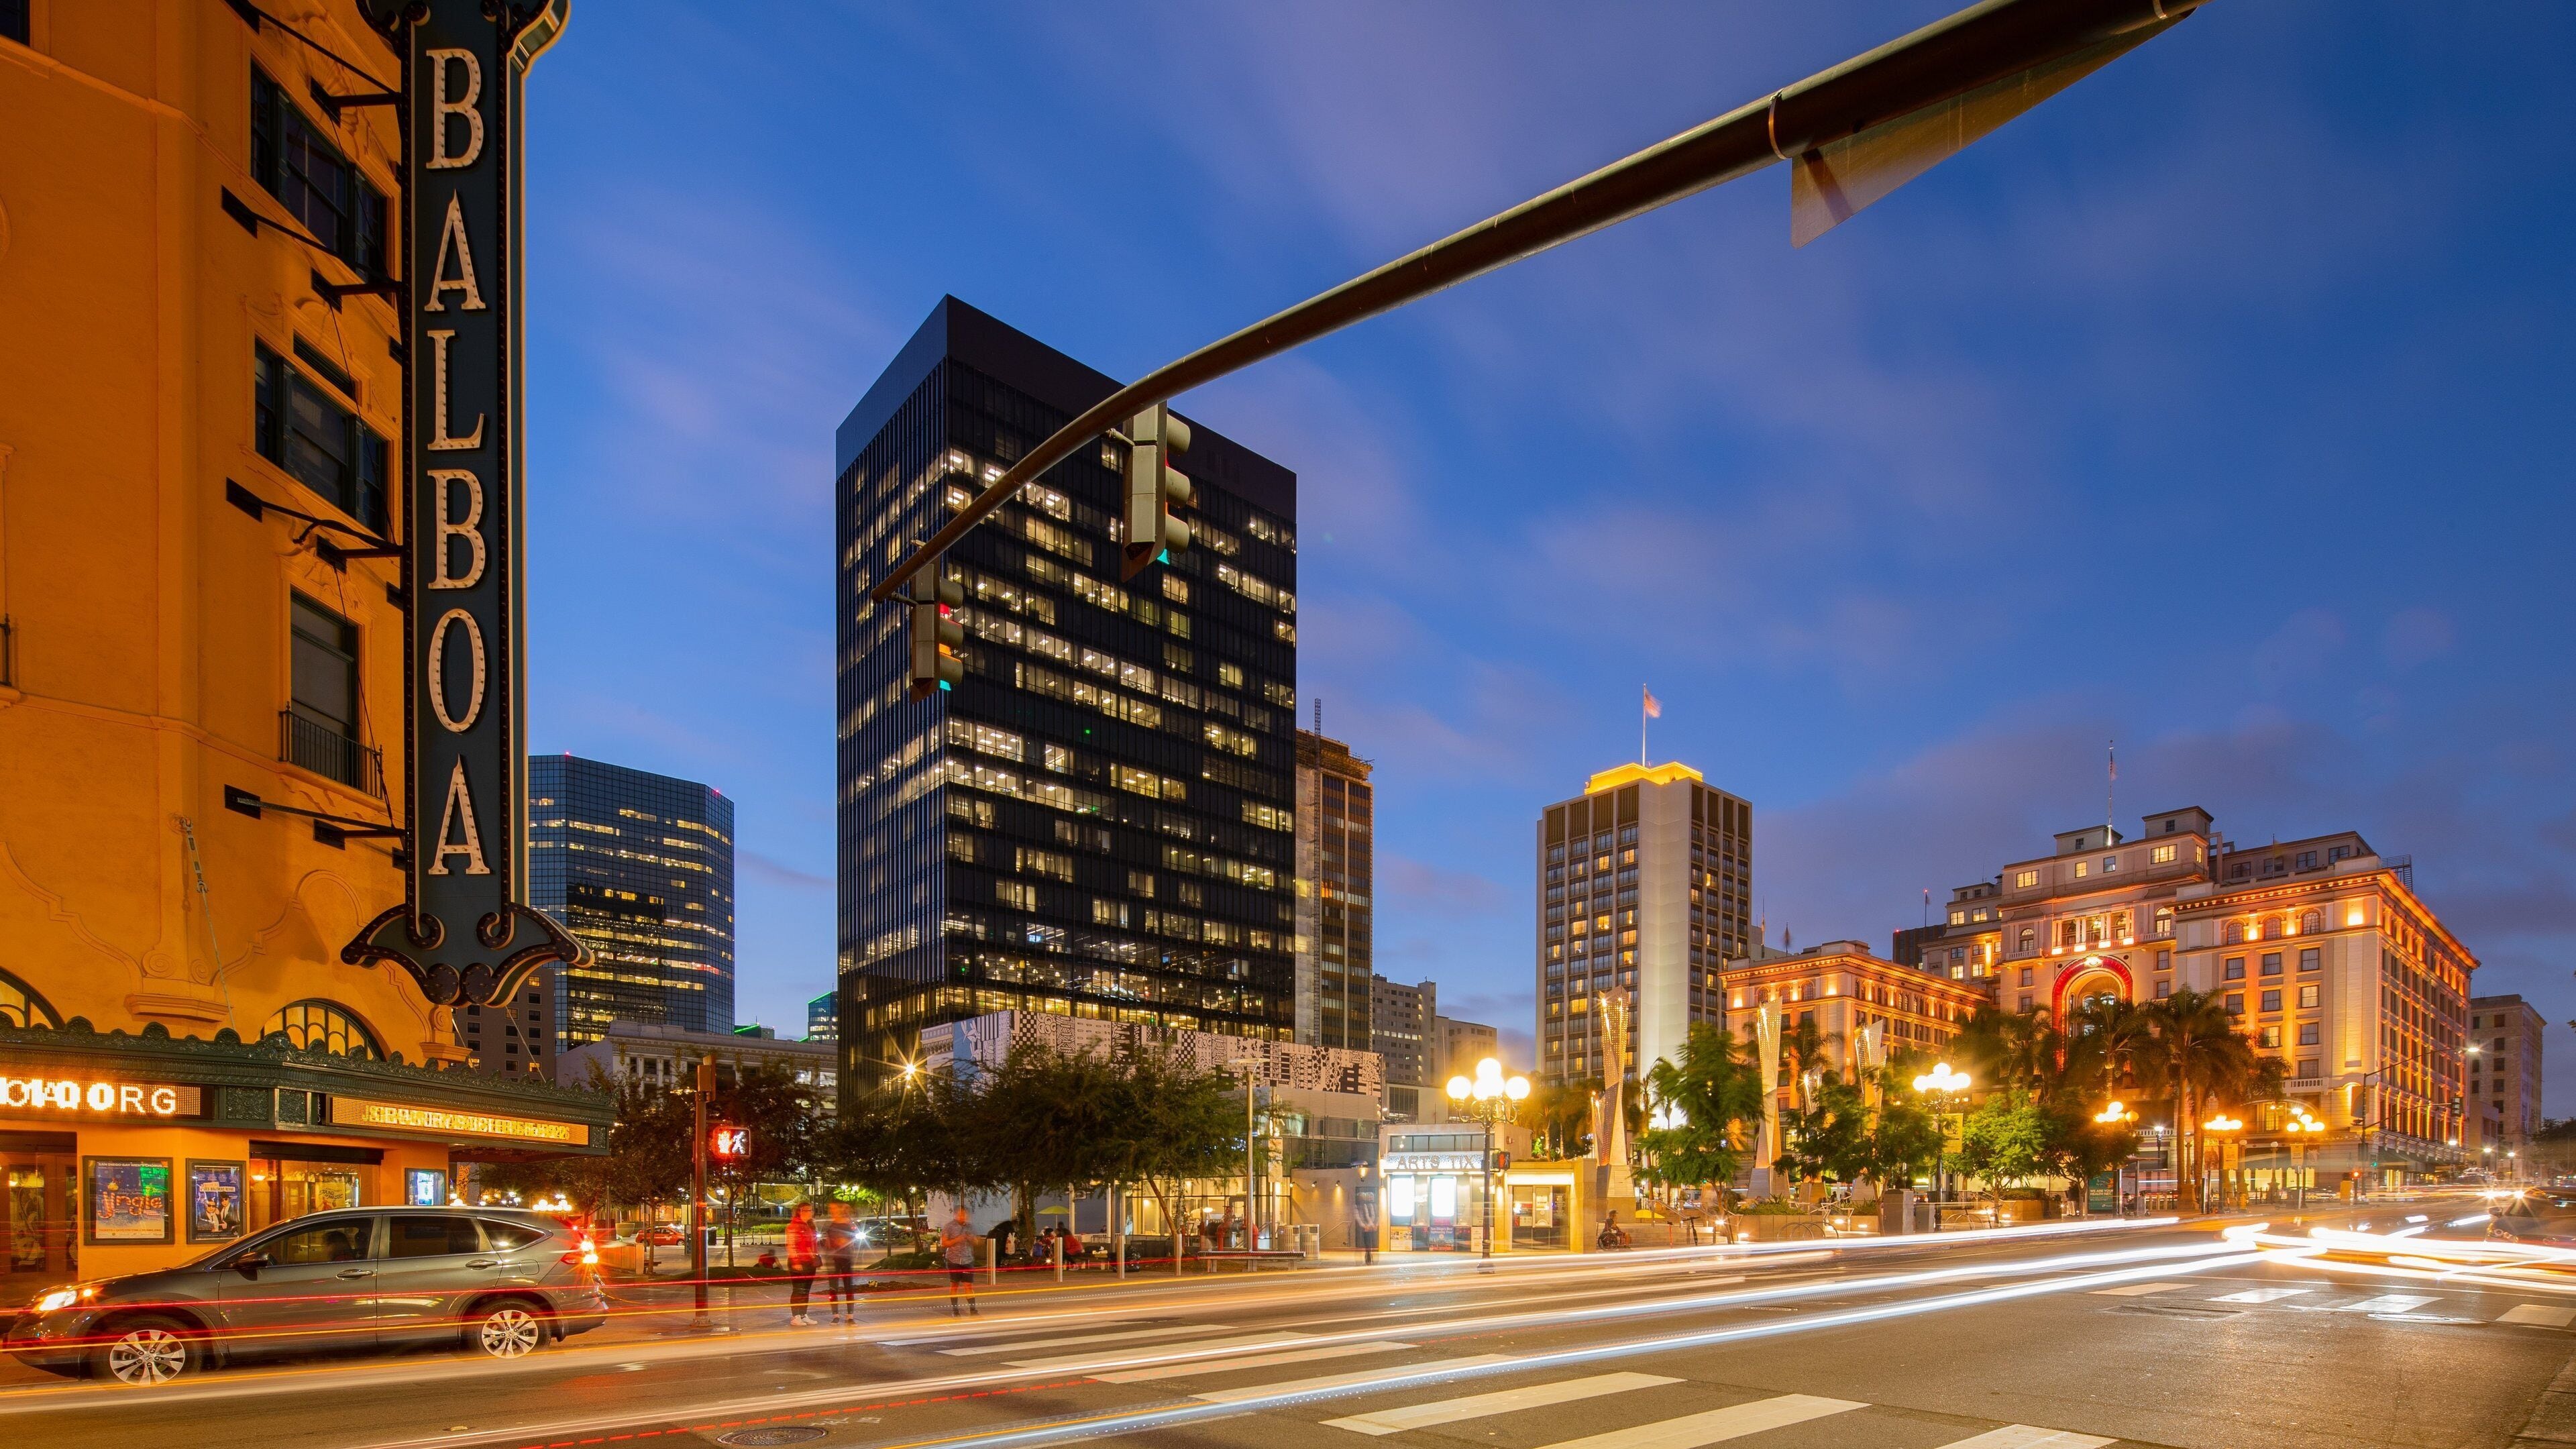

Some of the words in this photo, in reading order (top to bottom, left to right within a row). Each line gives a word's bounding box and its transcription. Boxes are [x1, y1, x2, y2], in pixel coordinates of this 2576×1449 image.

[424, 47, 490, 875] BALBOA
[1397, 1155, 1440, 1169] ARTS
[1448, 1155, 1476, 1169] TIX
[97, 1191, 163, 1219] jingle
